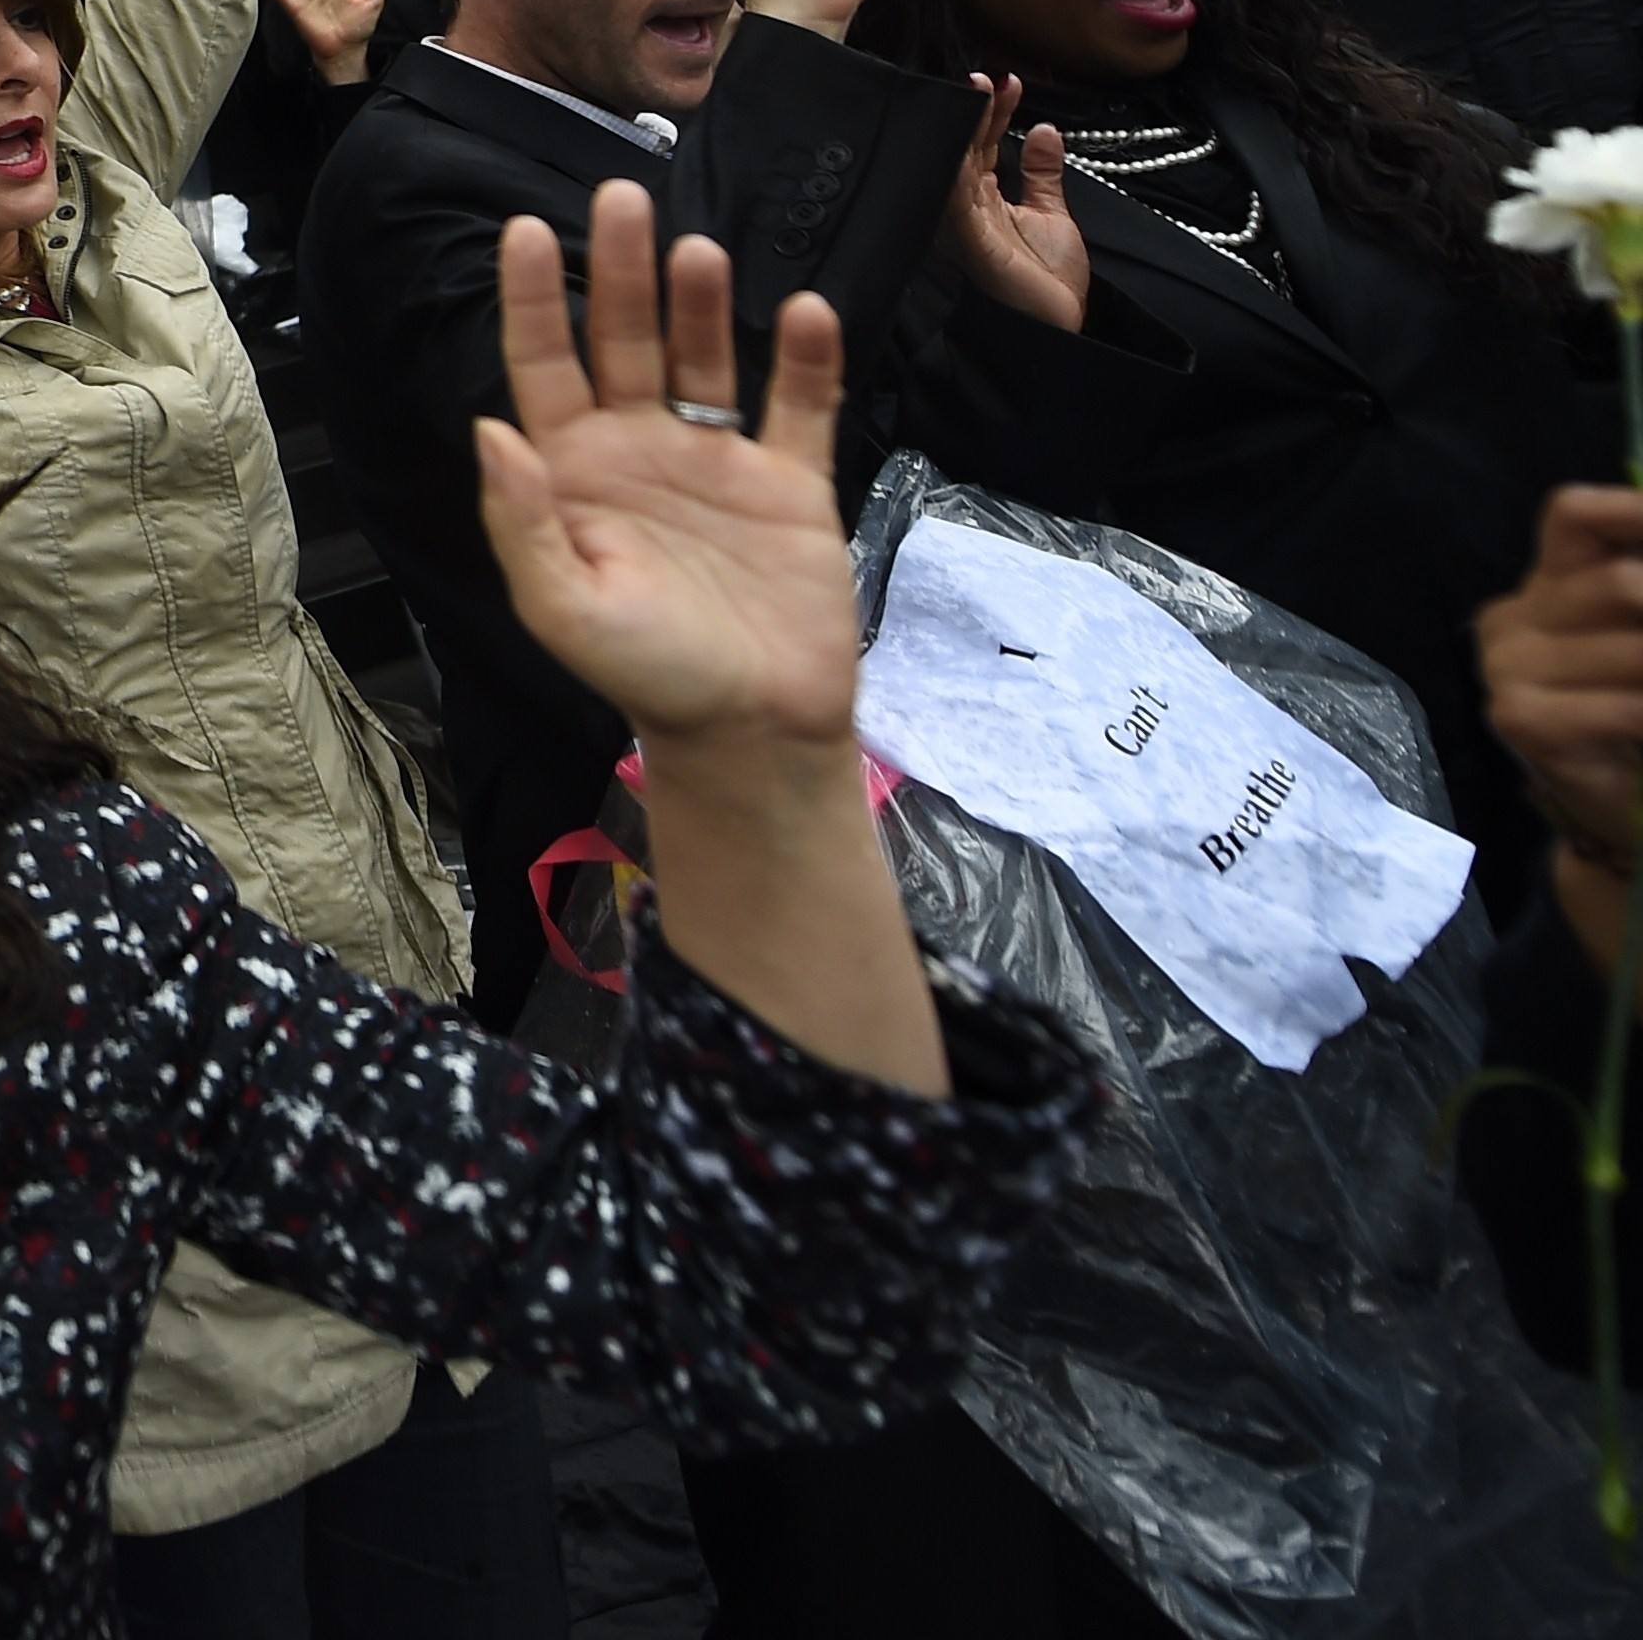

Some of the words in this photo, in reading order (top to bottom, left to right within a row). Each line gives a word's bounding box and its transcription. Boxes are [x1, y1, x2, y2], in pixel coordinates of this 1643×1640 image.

[999, 643, 1038, 660] I
[1103, 685, 1169, 757] Can't
[1198, 758, 1297, 874] Breathe
